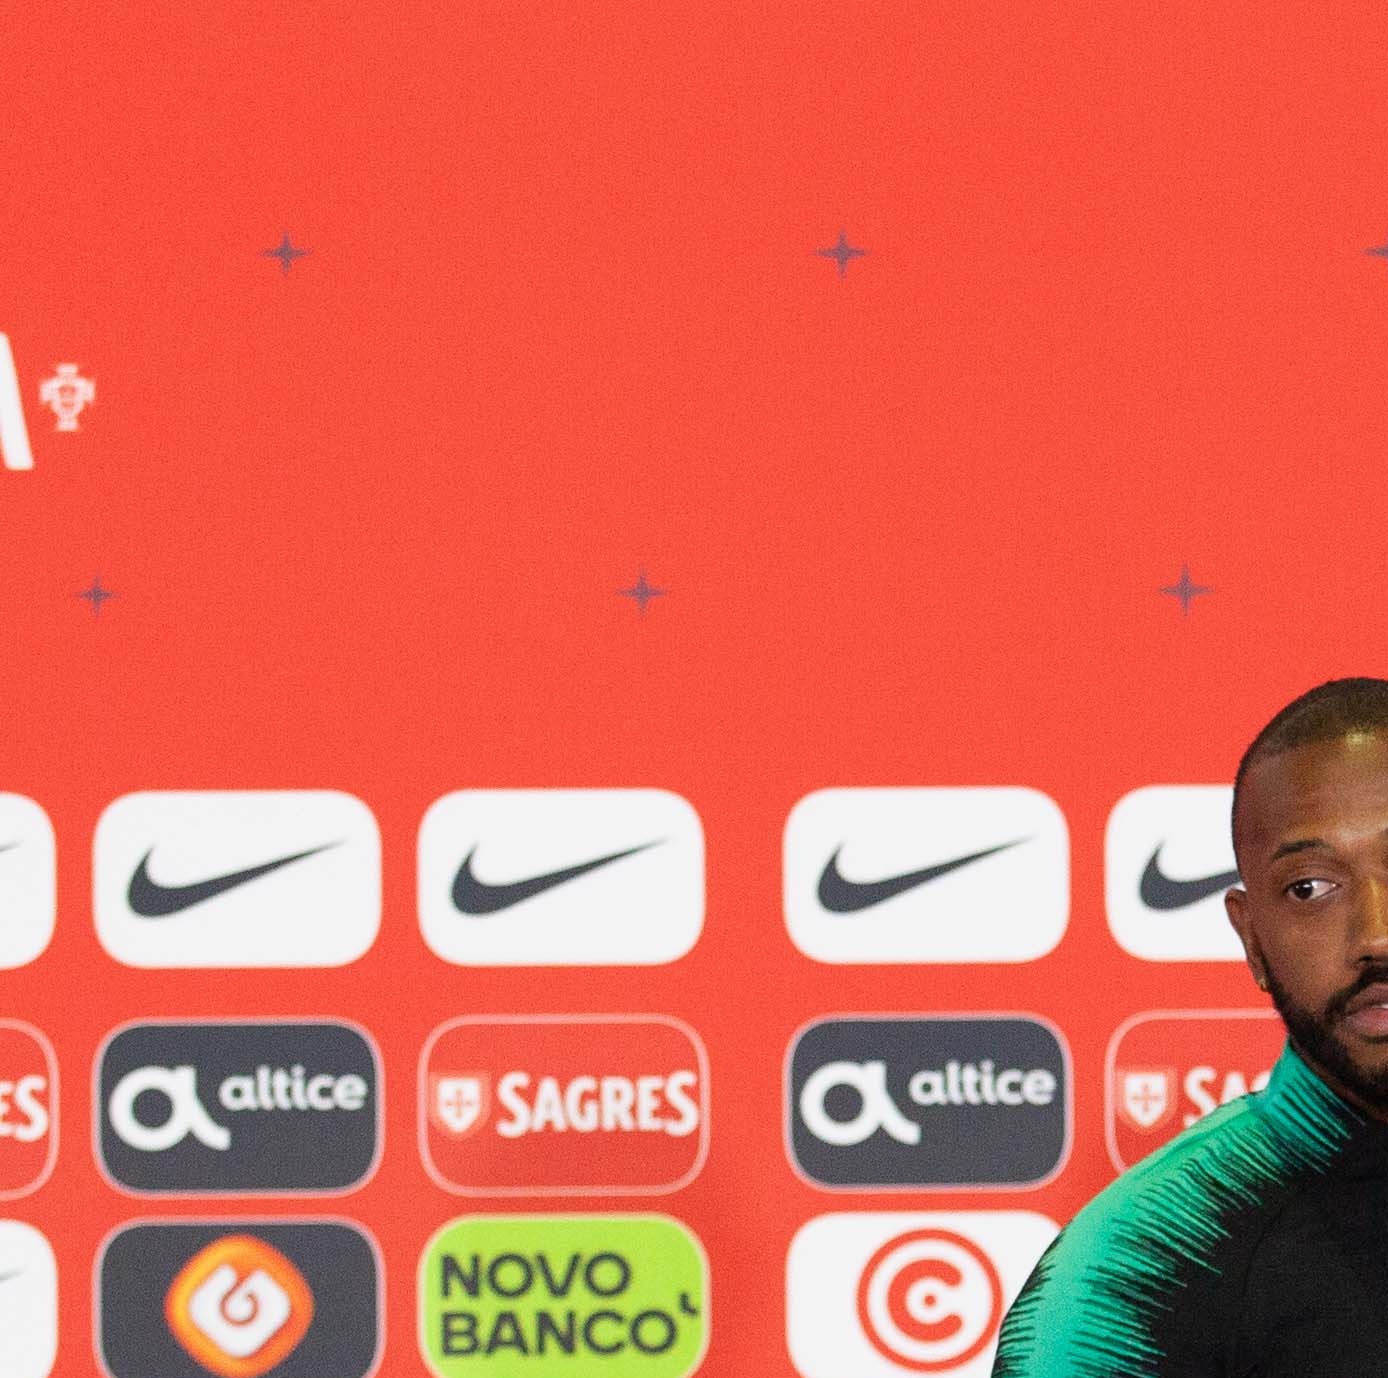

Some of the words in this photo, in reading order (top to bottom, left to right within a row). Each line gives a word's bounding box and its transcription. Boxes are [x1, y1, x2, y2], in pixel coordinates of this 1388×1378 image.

[219, 1065, 367, 1111] altice
[496, 1070, 700, 1138] SAGRES
[909, 1060, 1056, 1105] altice
[440, 1251, 633, 1300] NOVO
[440, 1308, 679, 1358] BANCO
